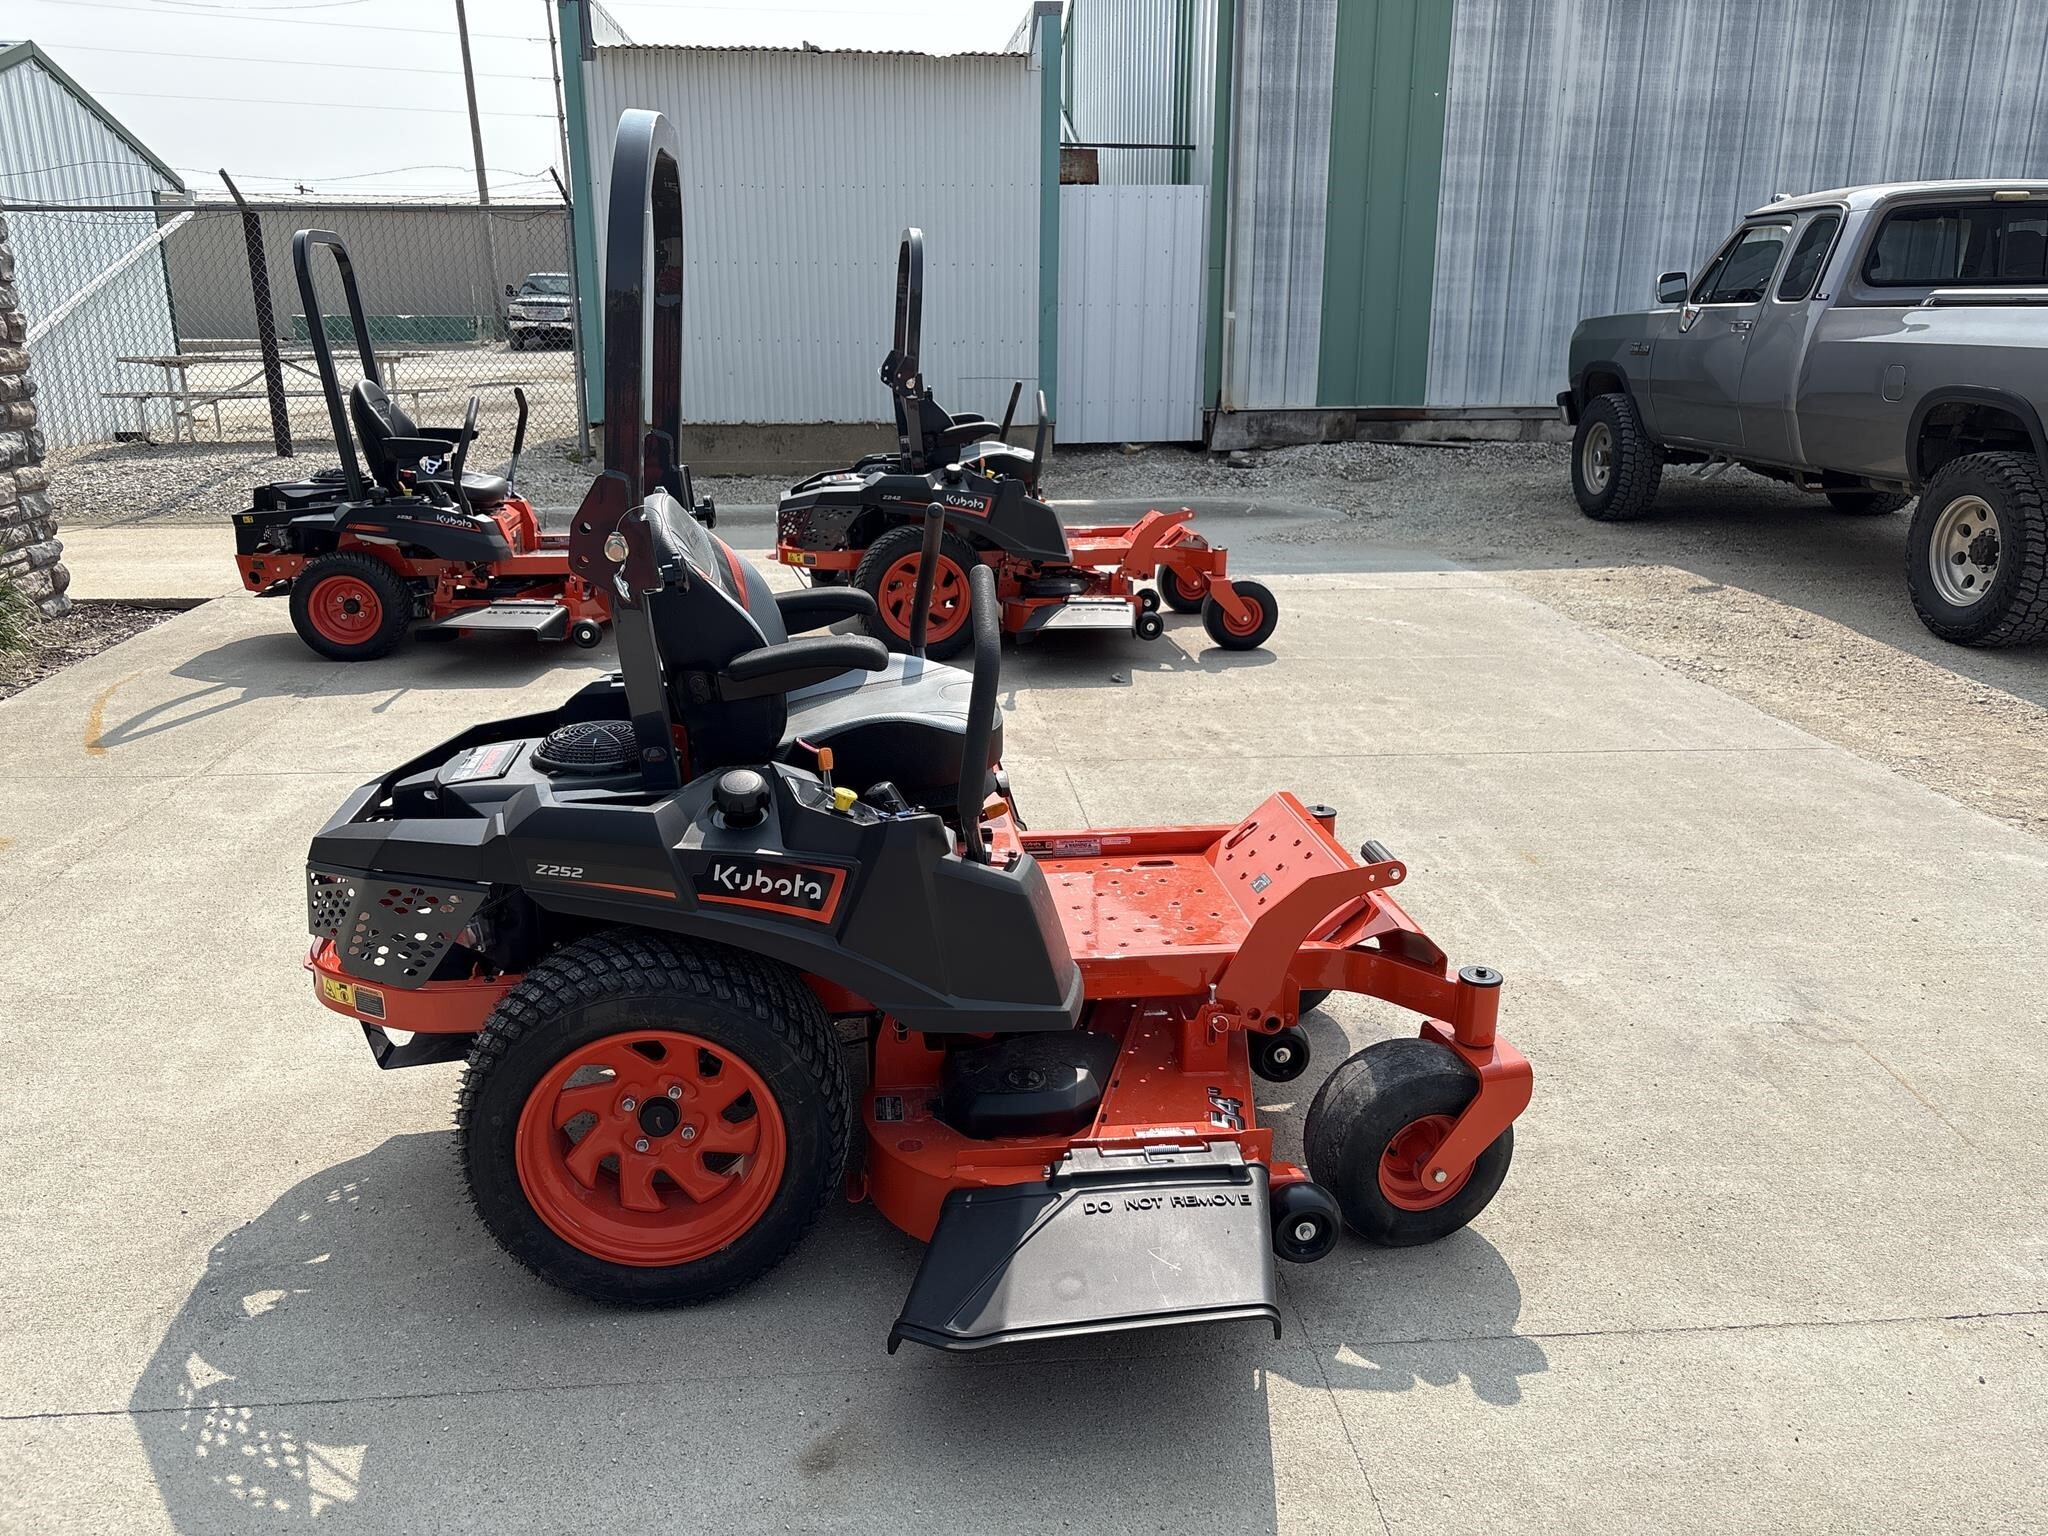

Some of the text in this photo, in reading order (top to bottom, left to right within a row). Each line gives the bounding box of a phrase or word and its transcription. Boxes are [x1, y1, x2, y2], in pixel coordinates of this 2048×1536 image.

[945, 494, 984, 509] Kubota
[436, 514, 472, 528] Kubota
[535, 863, 585, 879] Z252
[713, 863, 823, 900] Kubota
[1083, 1193, 1252, 1215] DO NOT REMOVE
